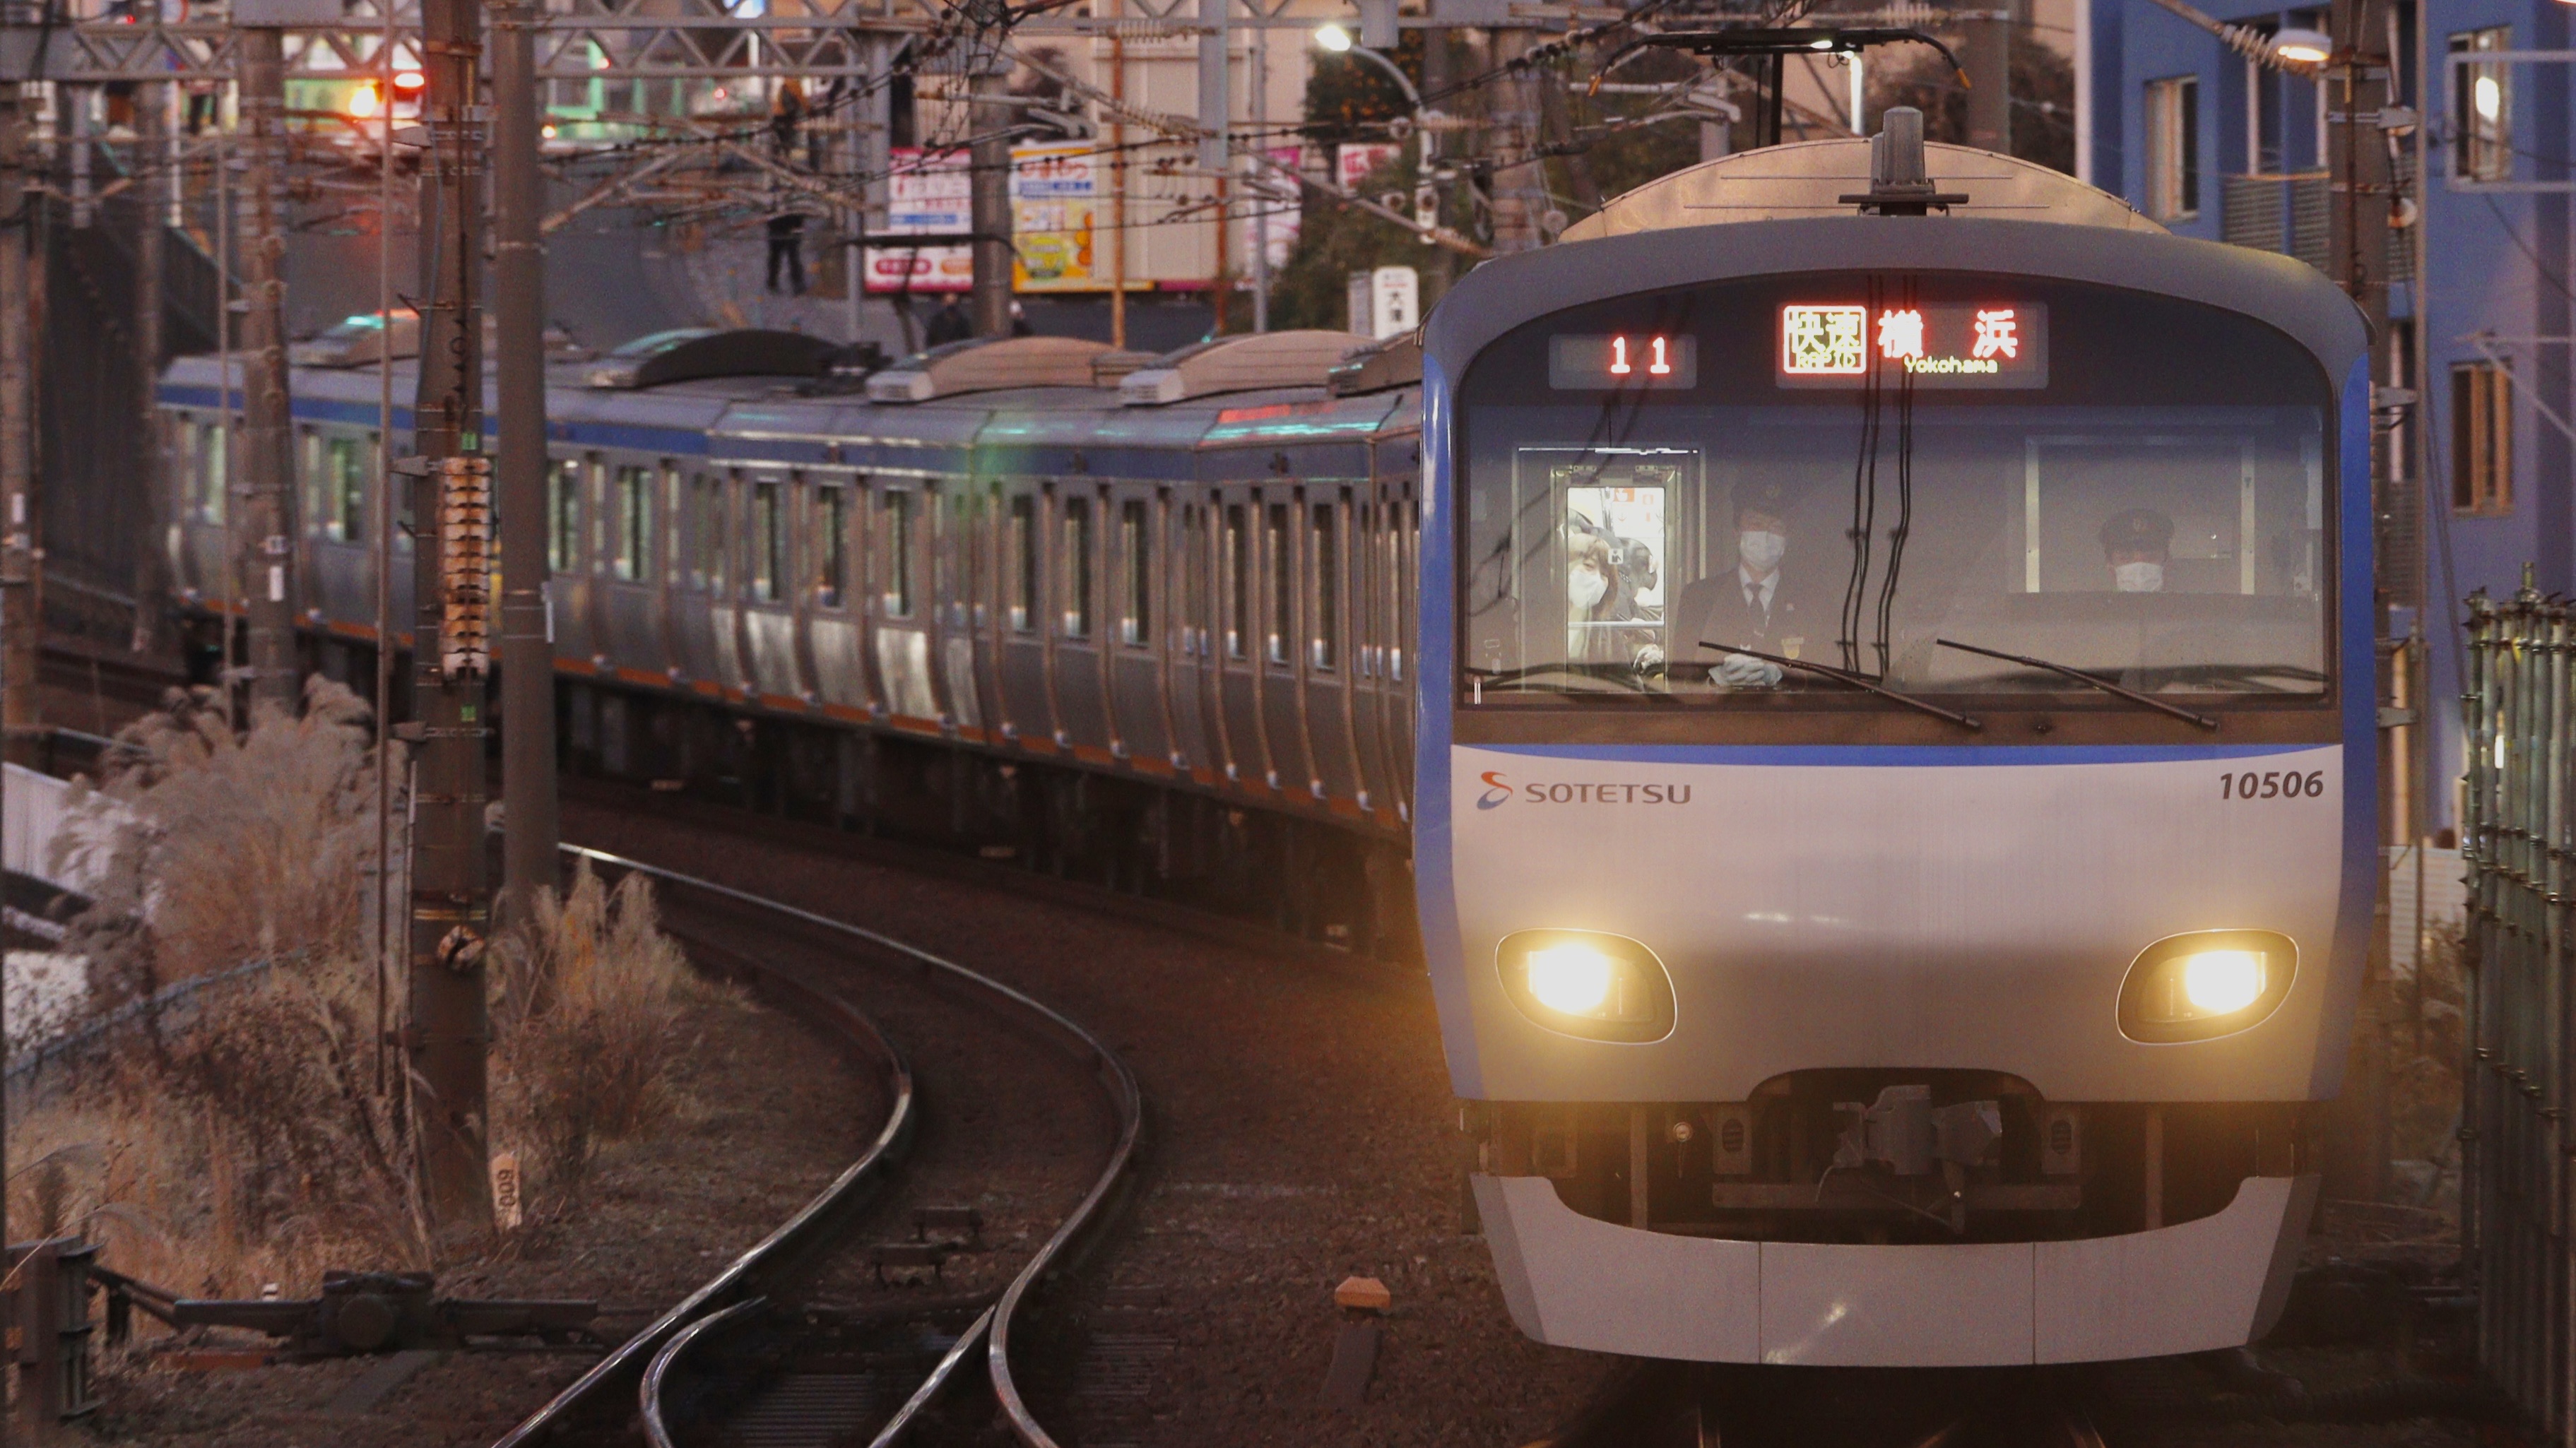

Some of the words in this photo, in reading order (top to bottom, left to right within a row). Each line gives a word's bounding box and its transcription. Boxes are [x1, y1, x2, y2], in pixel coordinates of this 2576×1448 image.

[1790, 311, 1862, 355] 快速
[1878, 309, 2019, 357] 横浜
[1611, 336, 1670, 374] 11
[1796, 351, 1857, 369] RAPID
[1903, 355, 1998, 374] Yokohama
[1525, 783, 1691, 804] SOTETSU
[2220, 770, 2323, 800] 10506
